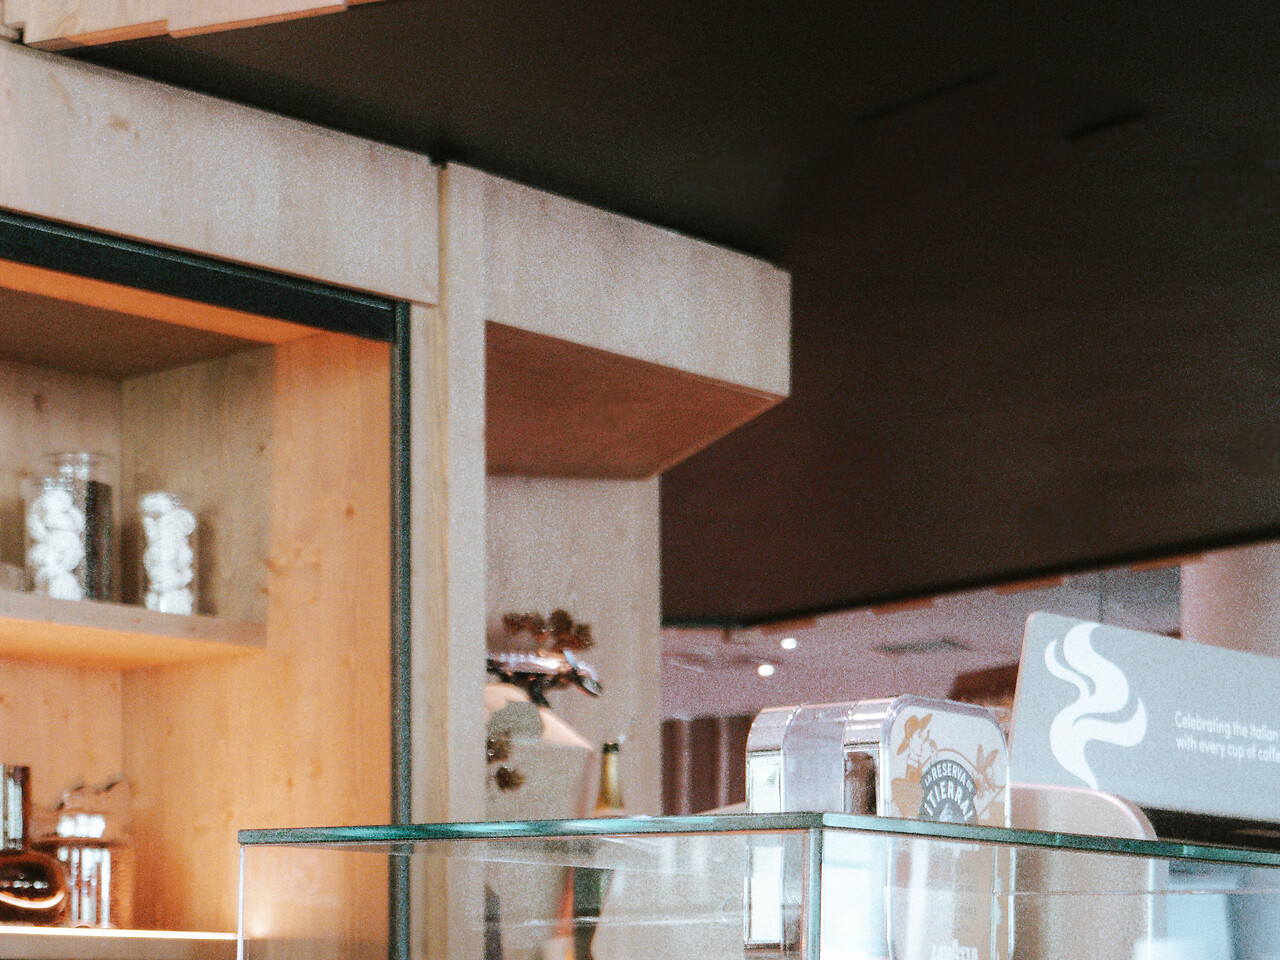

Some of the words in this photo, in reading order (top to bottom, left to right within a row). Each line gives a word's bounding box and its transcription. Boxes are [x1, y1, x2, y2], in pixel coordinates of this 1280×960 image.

[1174, 711, 1231, 739] Celebrating
[1233, 721, 1248, 737] the
[1249, 723, 1279, 742] Italian
[1175, 734, 1197, 752] with
[1198, 740, 1226, 760] every
[1227, 744, 1244, 762] cup
[1246, 743, 1257, 759] of
[931, 762, 966, 786] RESERVA
